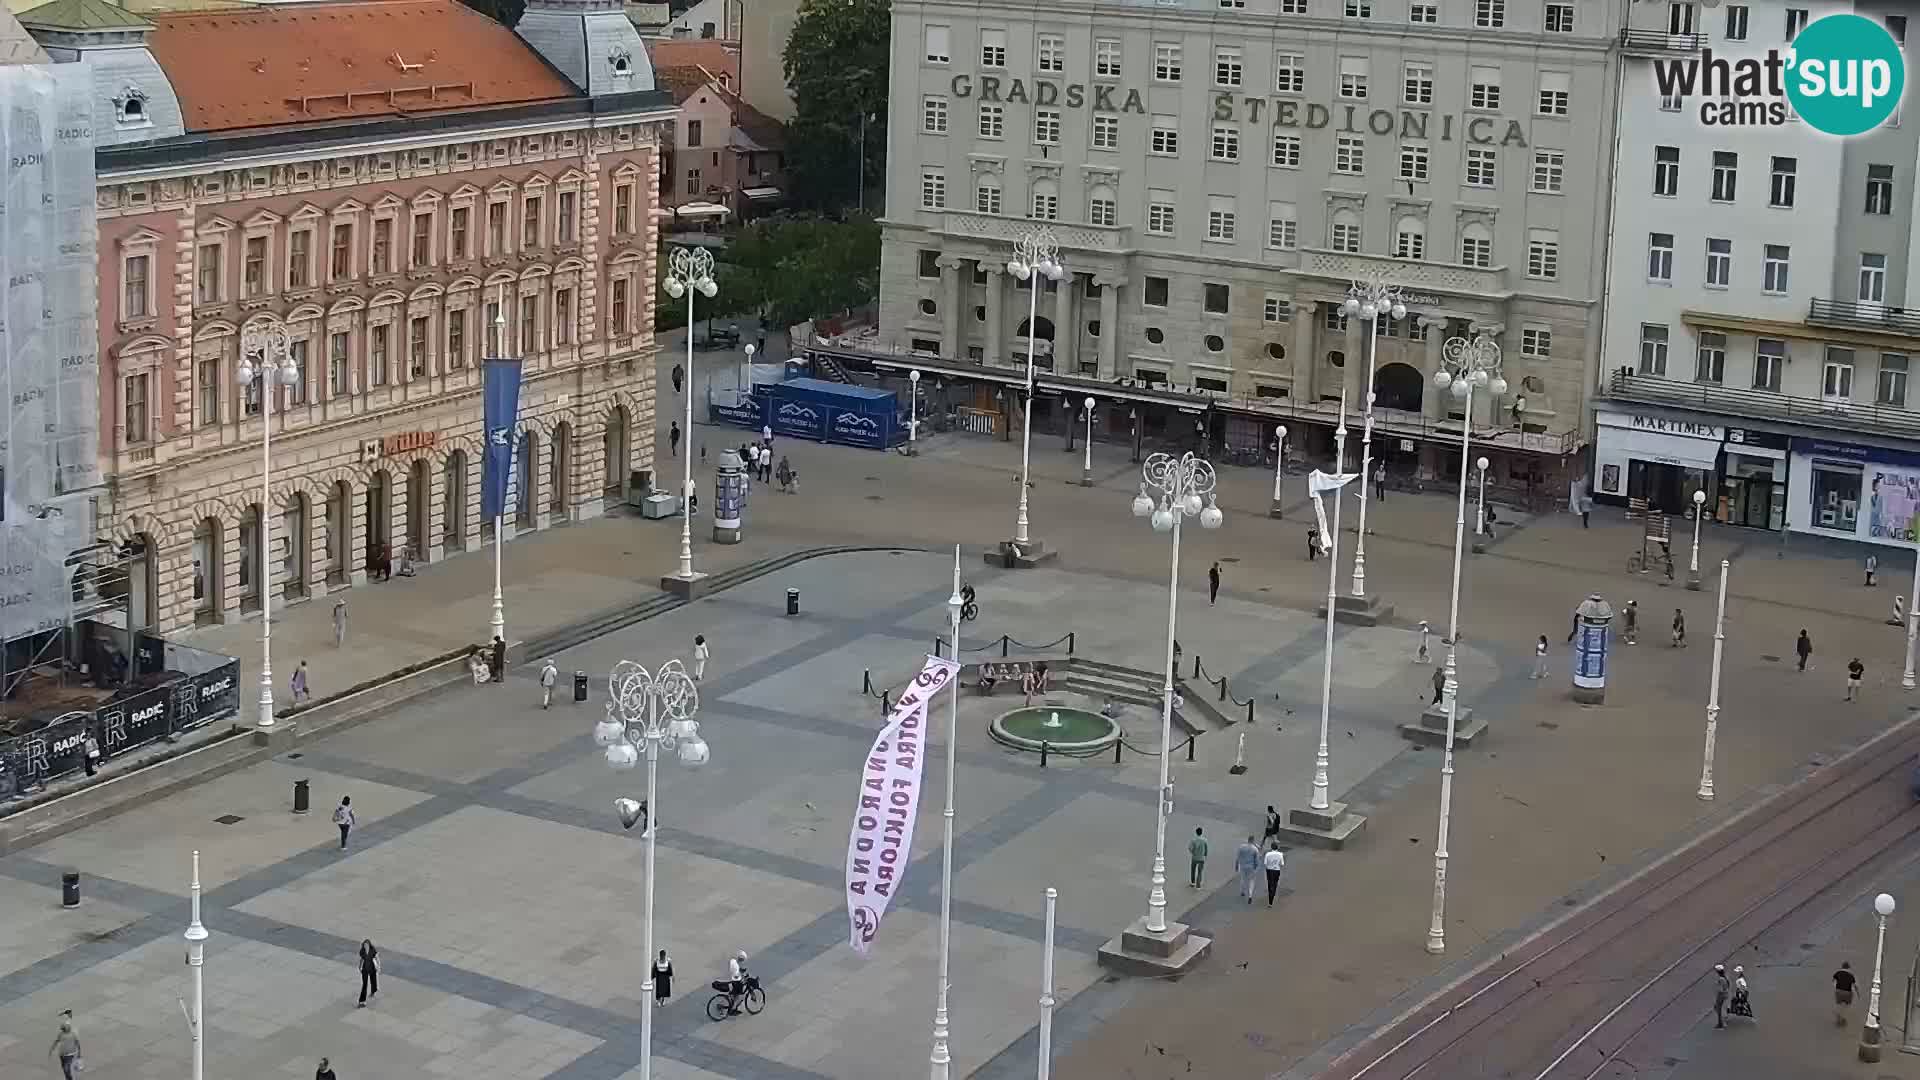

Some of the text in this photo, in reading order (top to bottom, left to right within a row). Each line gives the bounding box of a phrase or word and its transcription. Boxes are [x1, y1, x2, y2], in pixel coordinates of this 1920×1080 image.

[951, 74, 1146, 114] GRADSKA
[1633, 415, 1717, 437] MARTIMEX
[53, 728, 87, 753] RADIĆ
